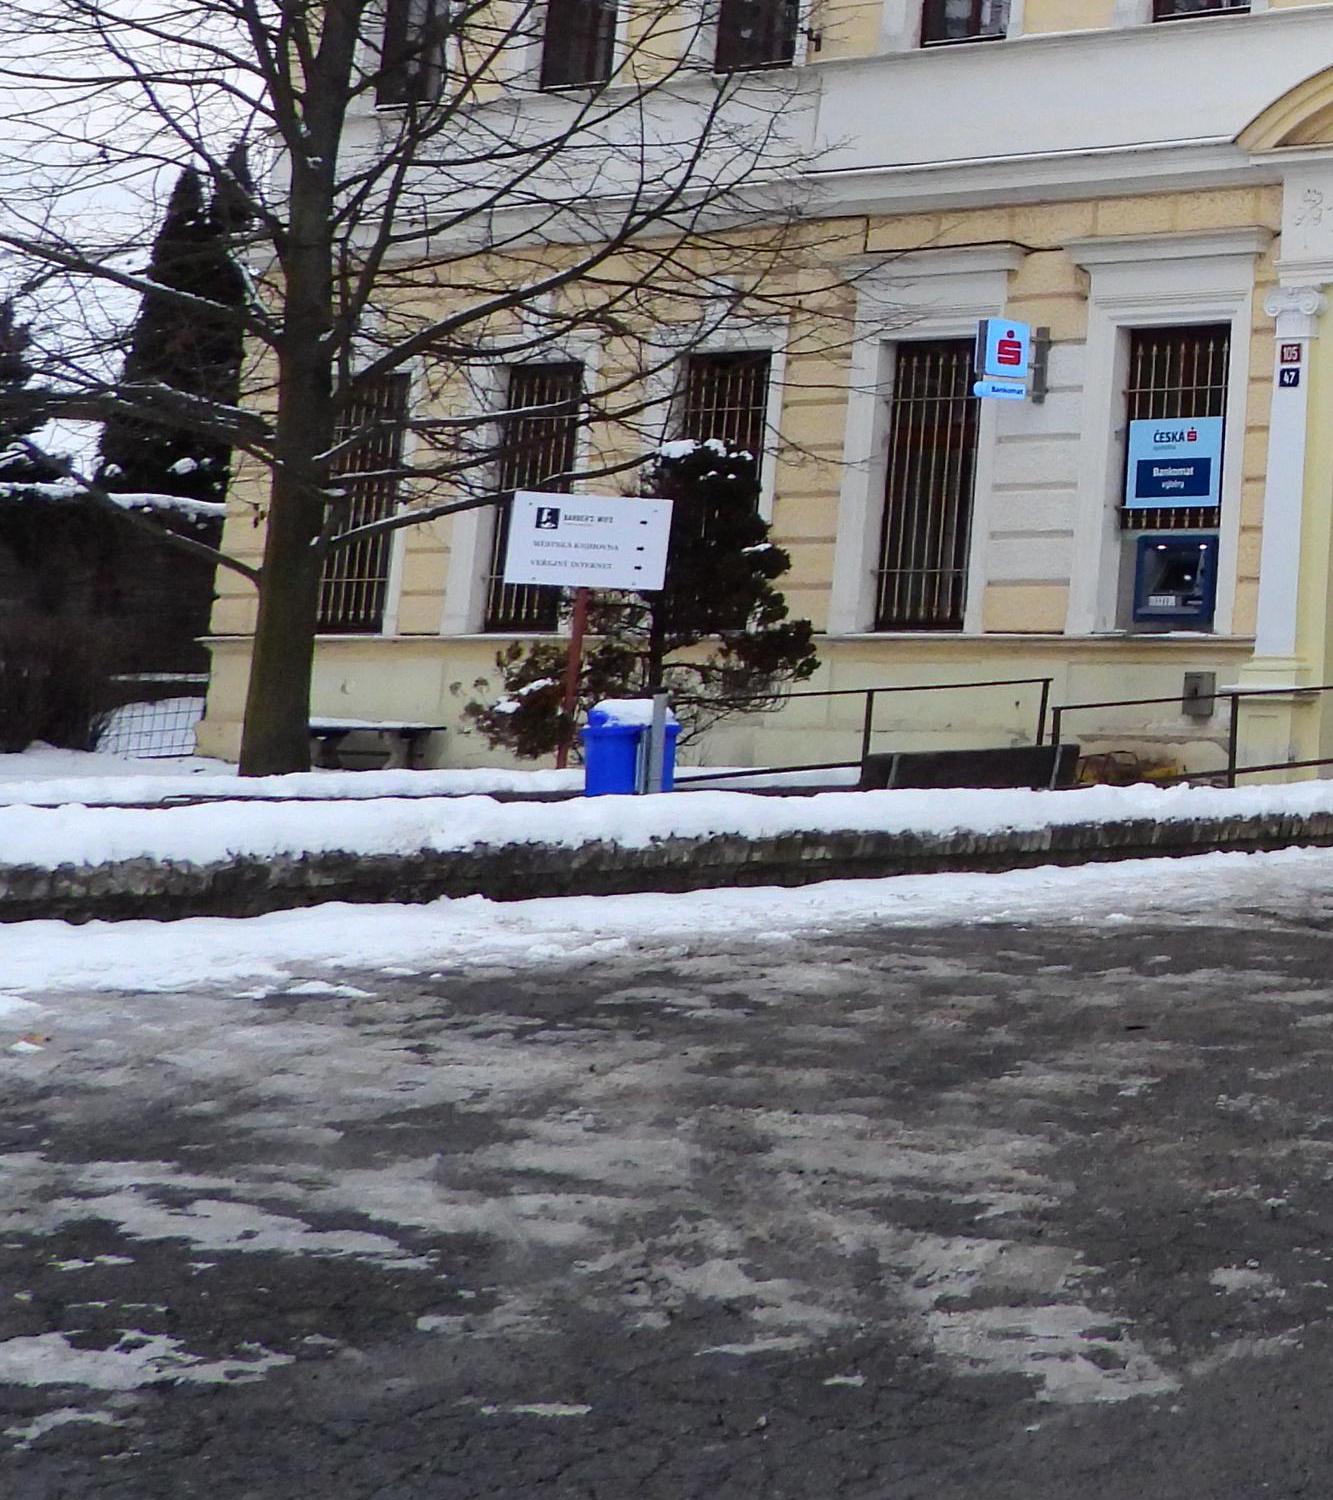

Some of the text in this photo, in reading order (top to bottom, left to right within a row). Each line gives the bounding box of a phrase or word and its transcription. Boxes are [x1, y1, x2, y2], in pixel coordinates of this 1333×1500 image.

[1283, 346, 1299, 360] 105
[1283, 371, 1296, 384] 47
[1154, 429, 1185, 443] ČESKÁ
